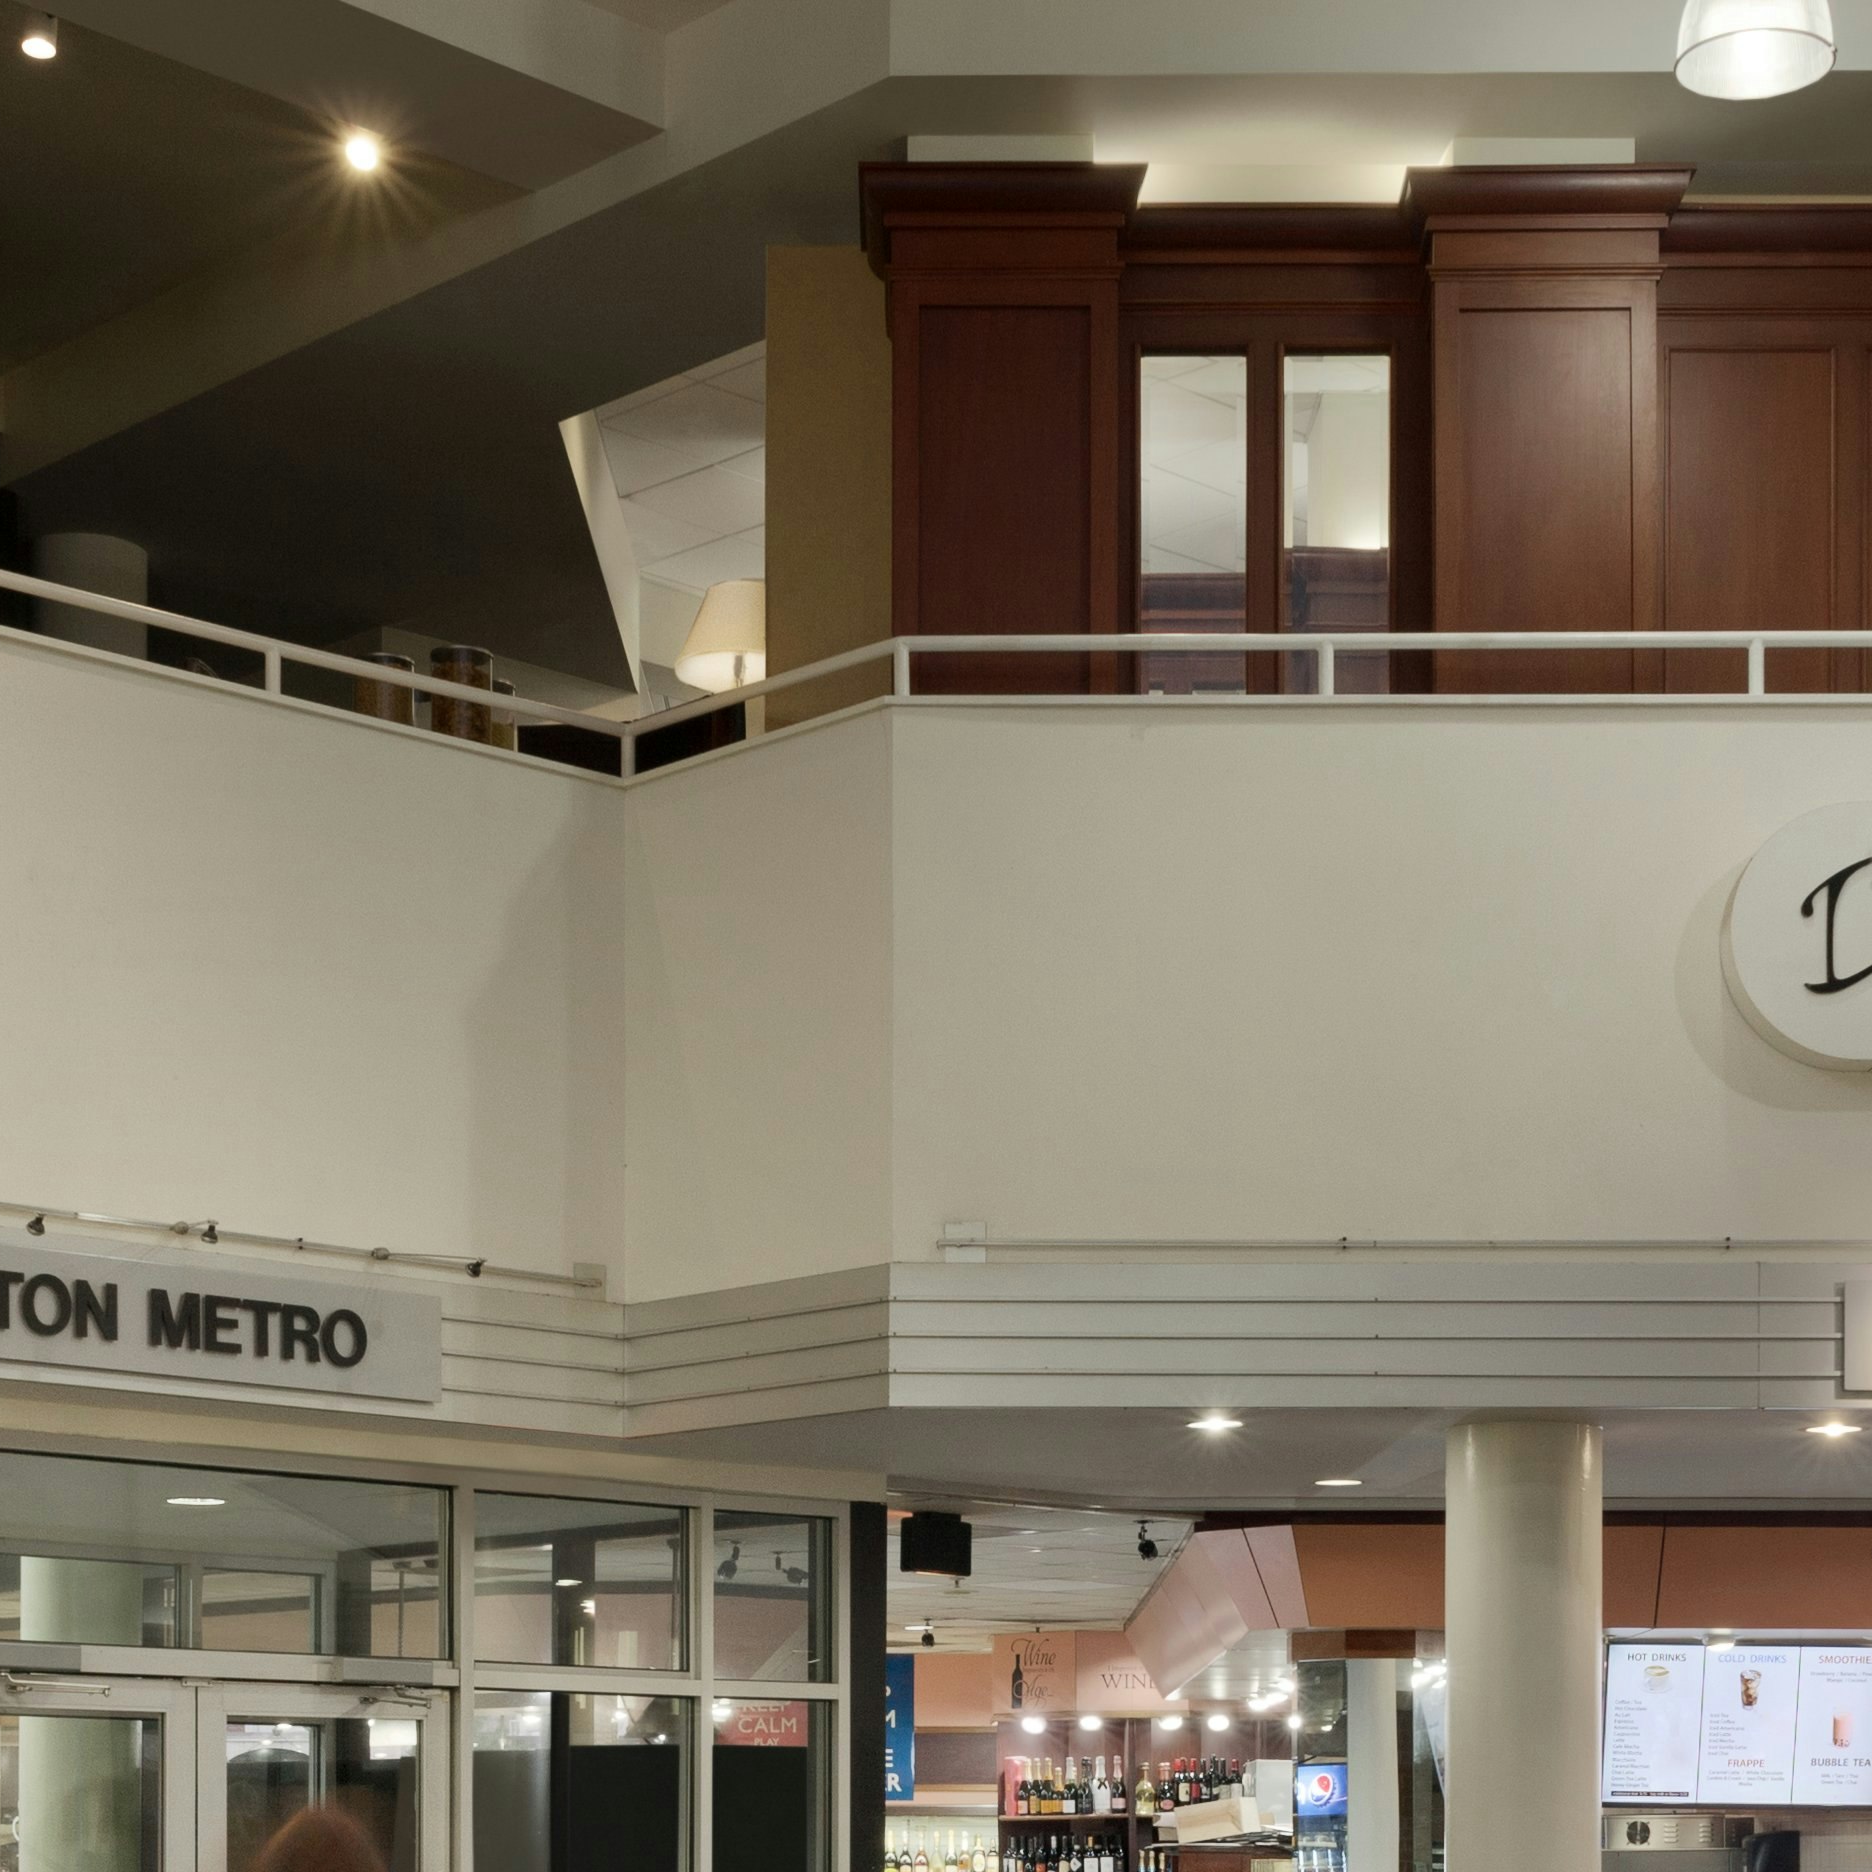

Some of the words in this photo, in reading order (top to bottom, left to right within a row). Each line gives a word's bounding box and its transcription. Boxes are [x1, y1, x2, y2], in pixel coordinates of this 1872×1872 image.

[149, 1288, 368, 1369] METRO
[1011, 1638, 1057, 1666] Wine
[1627, 1653, 1648, 1662] HOT
[1651, 1653, 1687, 1662] DRINKS
[1718, 1654, 1746, 1663] COLD
[1749, 1654, 1787, 1664] DRINKS
[738, 1717, 797, 1734] CALM
[1728, 1759, 1765, 1768] FRAPPE
[1810, 1758, 1848, 1767] BUBBLE
[1853, 1758, 1871, 1767] TEA
